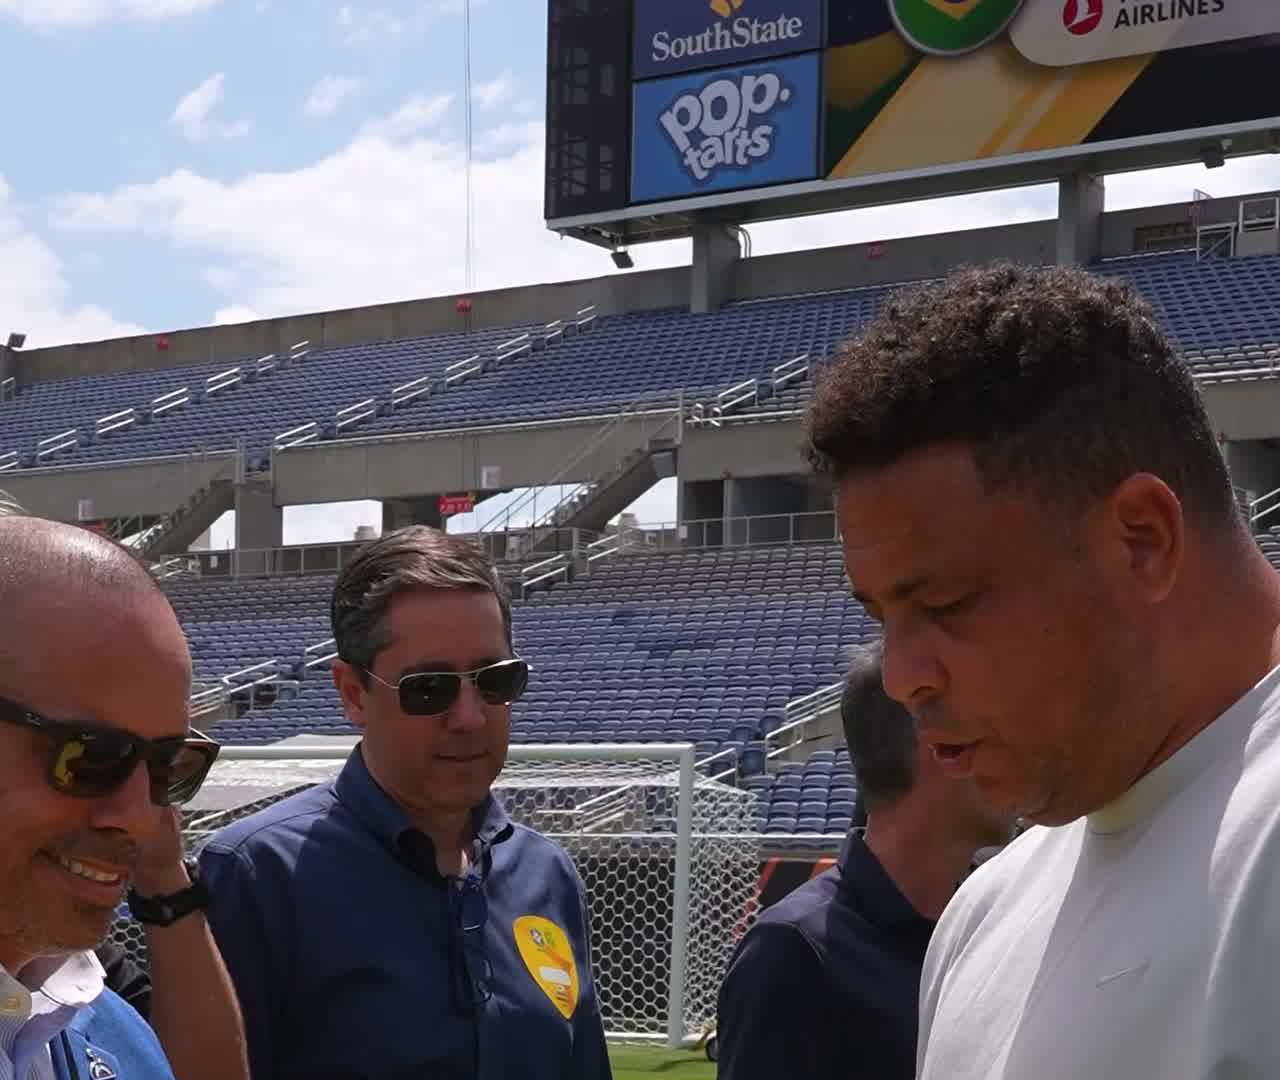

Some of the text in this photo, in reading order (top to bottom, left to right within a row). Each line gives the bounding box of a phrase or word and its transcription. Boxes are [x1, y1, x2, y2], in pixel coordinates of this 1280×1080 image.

[651, 14, 803, 62] SouthState
[1114, 0, 1225, 29] AIRLINES
[684, 124, 773, 181] tarts
